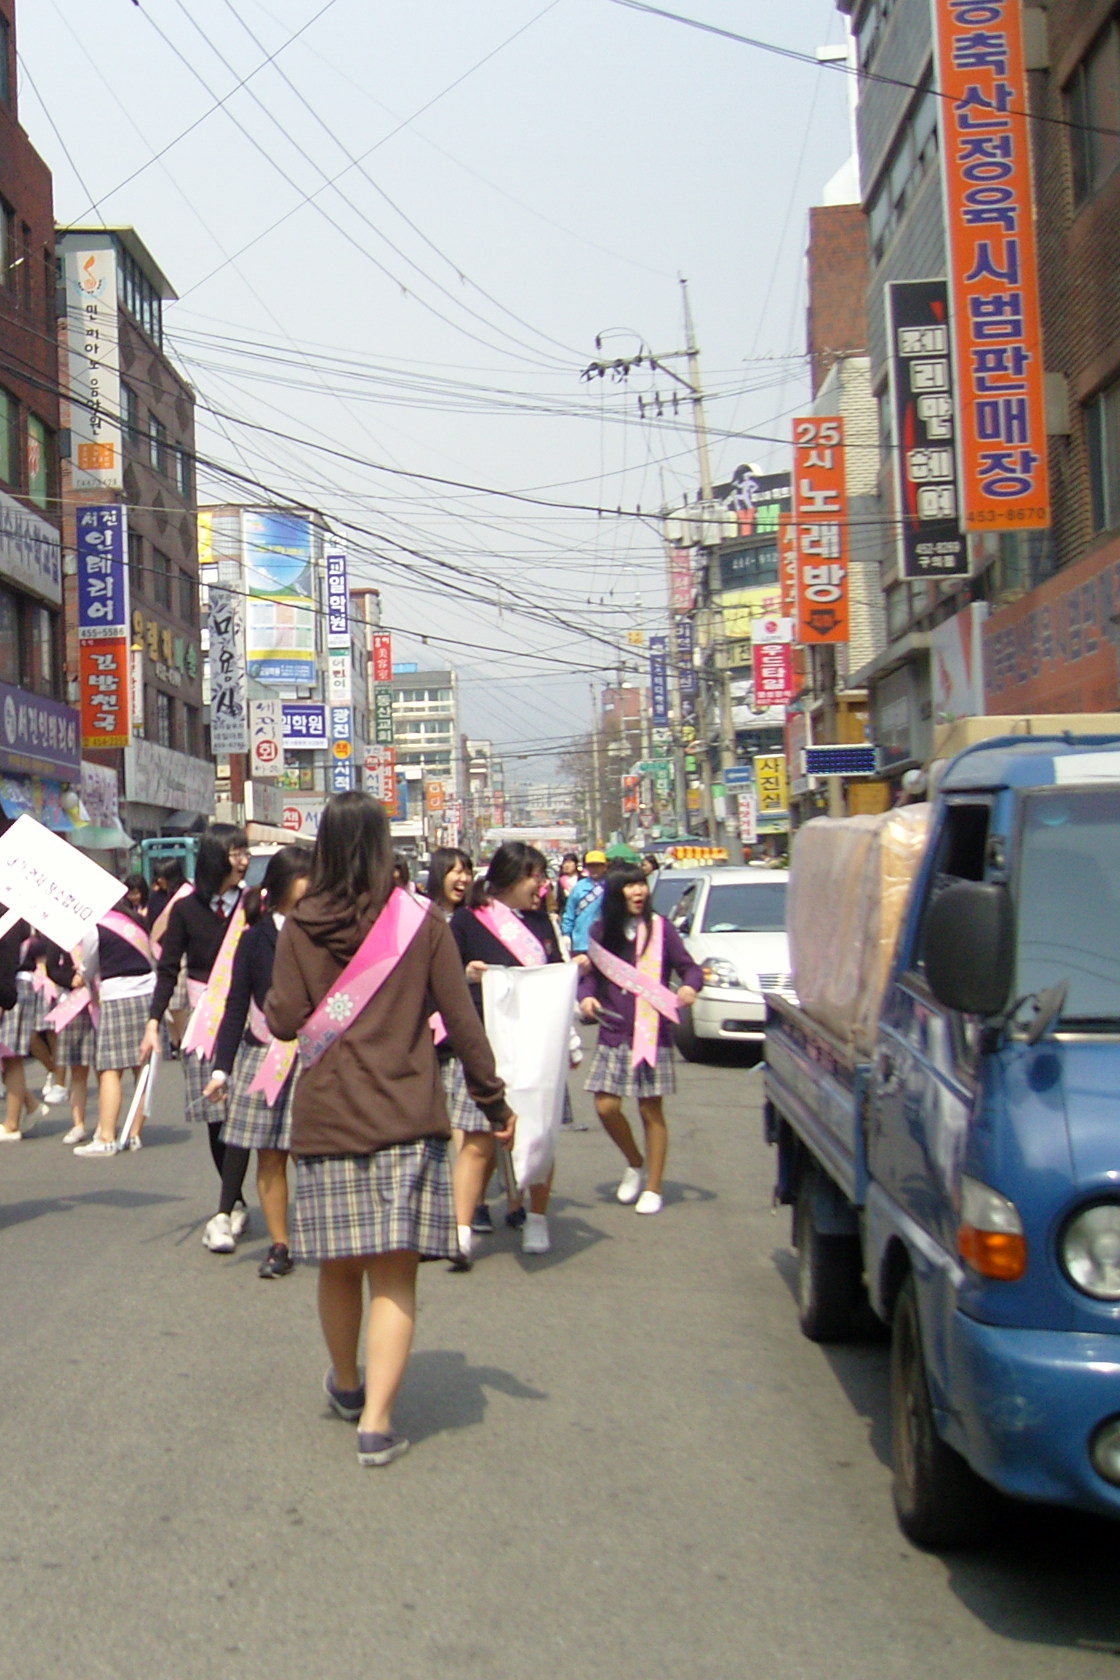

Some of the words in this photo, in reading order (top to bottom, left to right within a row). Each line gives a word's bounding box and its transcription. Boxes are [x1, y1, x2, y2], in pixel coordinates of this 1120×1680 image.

[796, 422, 841, 471] 25시
[81, 510, 118, 527] 서진
[966, 507, 1046, 525] 453-8670
[799, 484, 847, 603] 노래방
[85, 529, 114, 621] 인테리어
[88, 653, 120, 732] 김밥천국
[759, 758, 782, 809] 사진실
